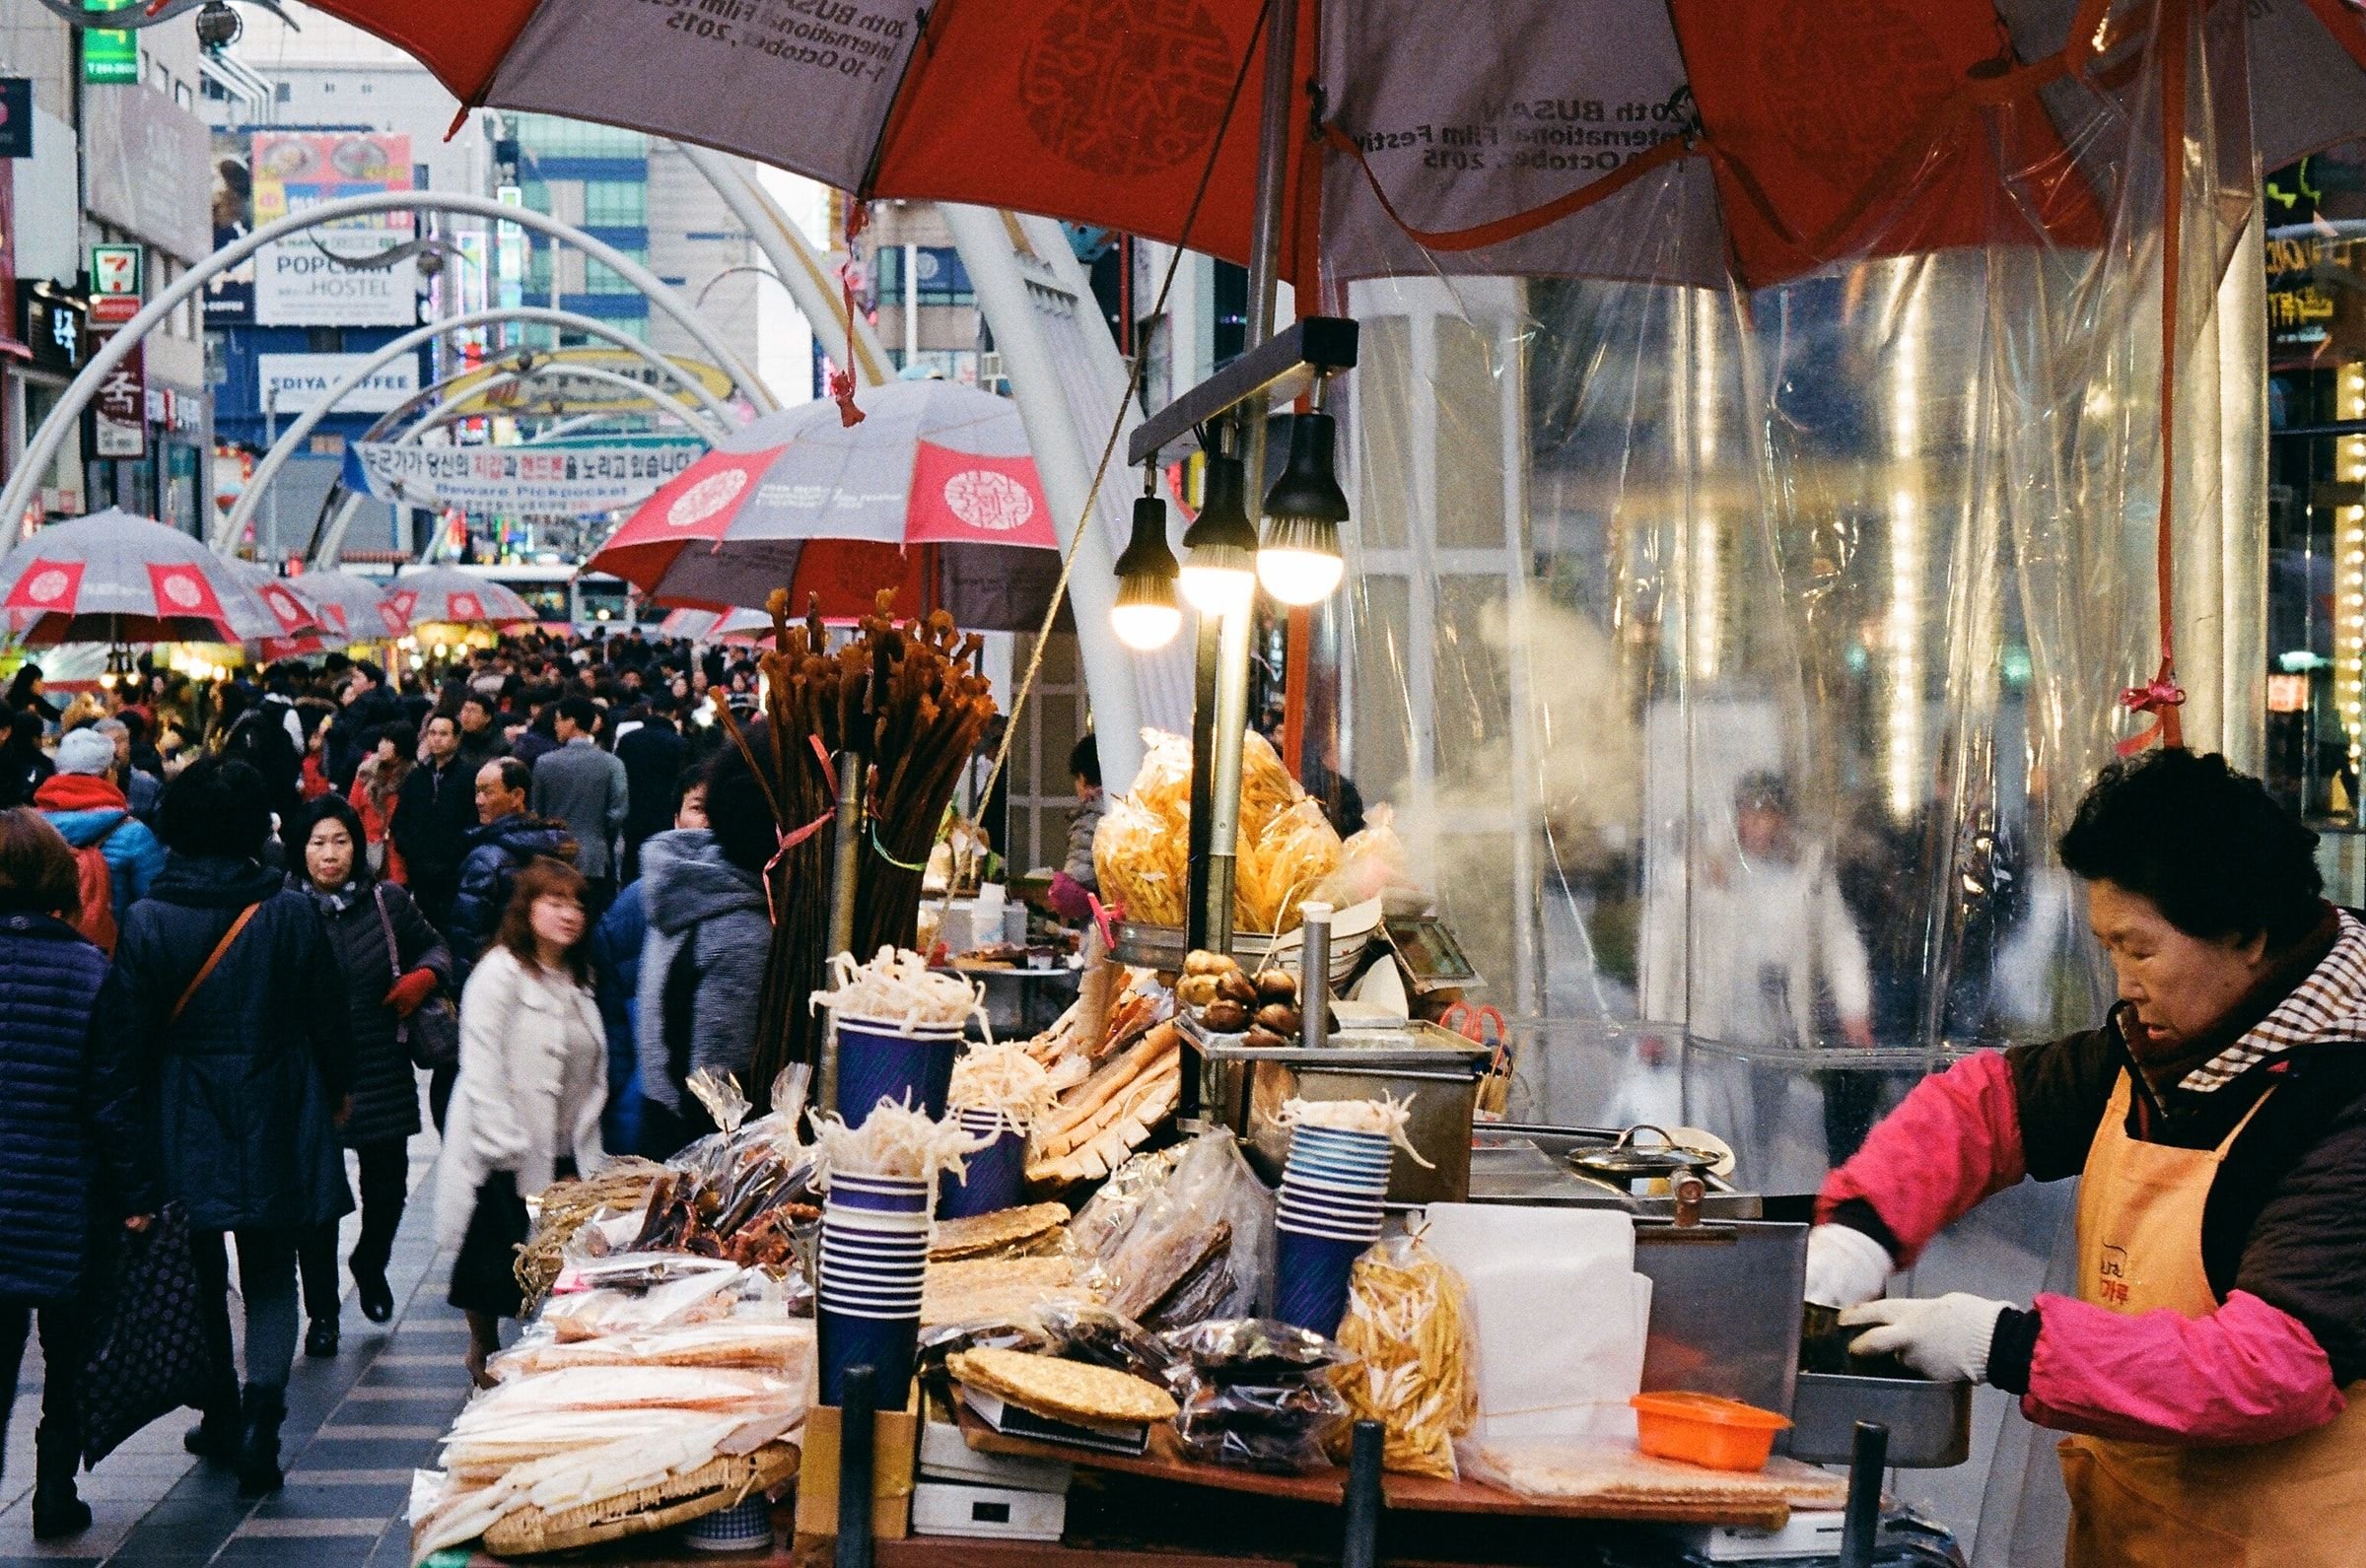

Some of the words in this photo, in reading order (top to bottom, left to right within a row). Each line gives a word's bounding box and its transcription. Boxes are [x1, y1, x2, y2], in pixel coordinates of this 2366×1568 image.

[307, 278, 392, 297] HOSTEL
[363, 448, 422, 475] 누군가가
[426, 451, 469, 478] 당신의
[583, 454, 626, 480] 노리고
